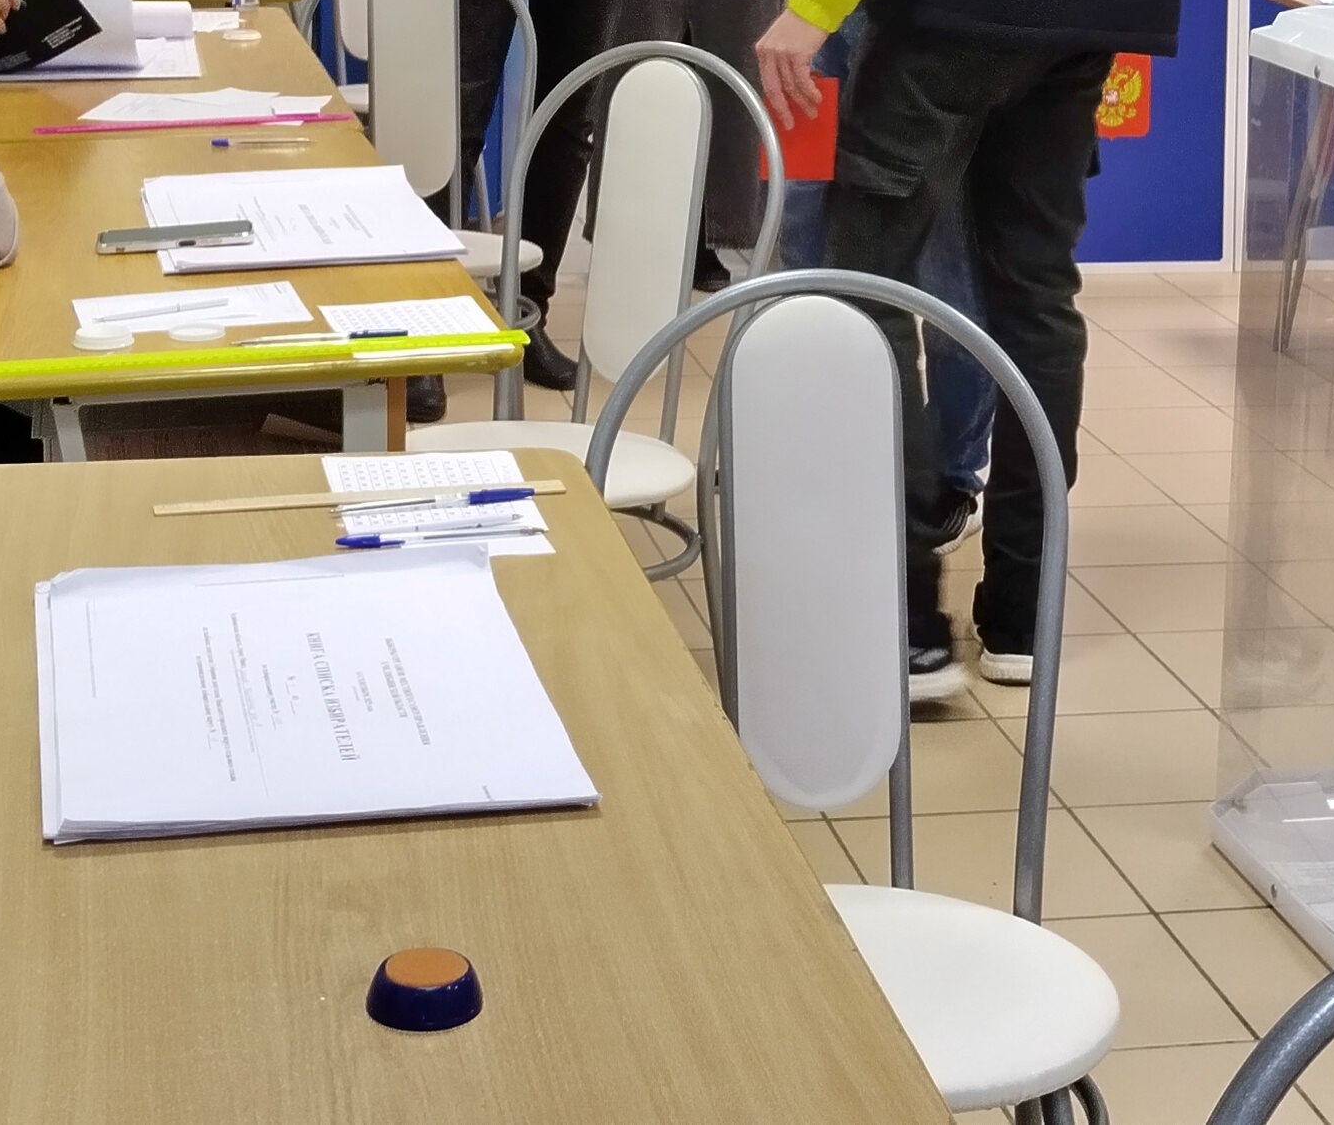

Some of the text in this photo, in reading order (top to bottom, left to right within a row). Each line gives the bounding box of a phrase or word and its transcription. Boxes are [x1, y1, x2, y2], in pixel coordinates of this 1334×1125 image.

[306, 632, 361, 761] КНИГА СПИСКА ИЗБИРАТЕЛЕЙ
